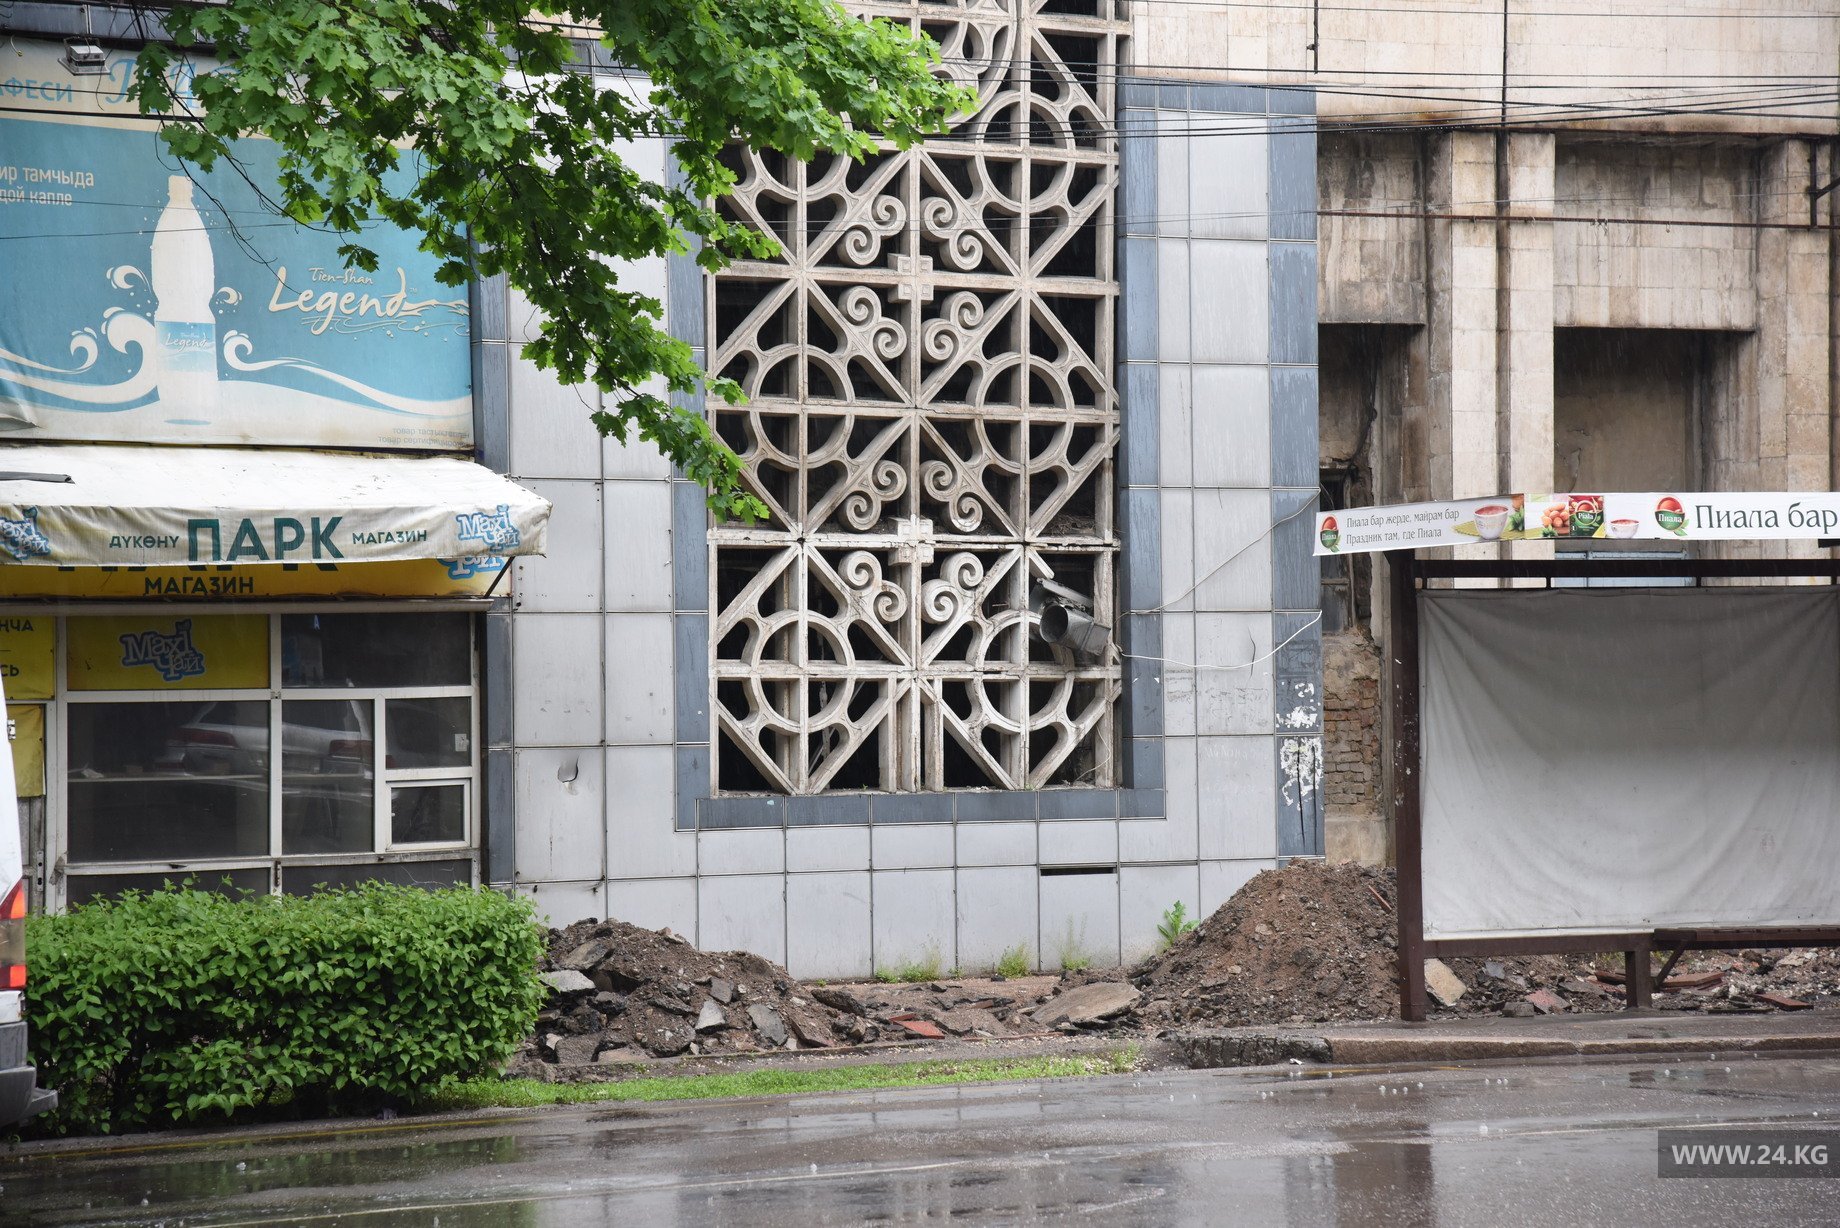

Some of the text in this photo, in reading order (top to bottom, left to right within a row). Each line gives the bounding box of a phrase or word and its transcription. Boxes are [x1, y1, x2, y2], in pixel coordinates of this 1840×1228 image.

[0, 77, 73, 103] ФЕСИ
[22, 167, 95, 189] тамчыда
[30, 191, 73, 206] капле
[268, 266, 407, 335] Legend
[1346, 508, 1460, 528] Пиала бар жерде, майрам бар
[1658, 513, 1683, 523] Пиала
[1695, 502, 1838, 534] Пиала бар
[188, 516, 345, 562] ПАРК
[352, 529, 428, 545] МАГАЗИН
[1346, 528, 1442, 546] Праздник там, где Пиала
[143, 577, 254, 594] МАГАЗИН
